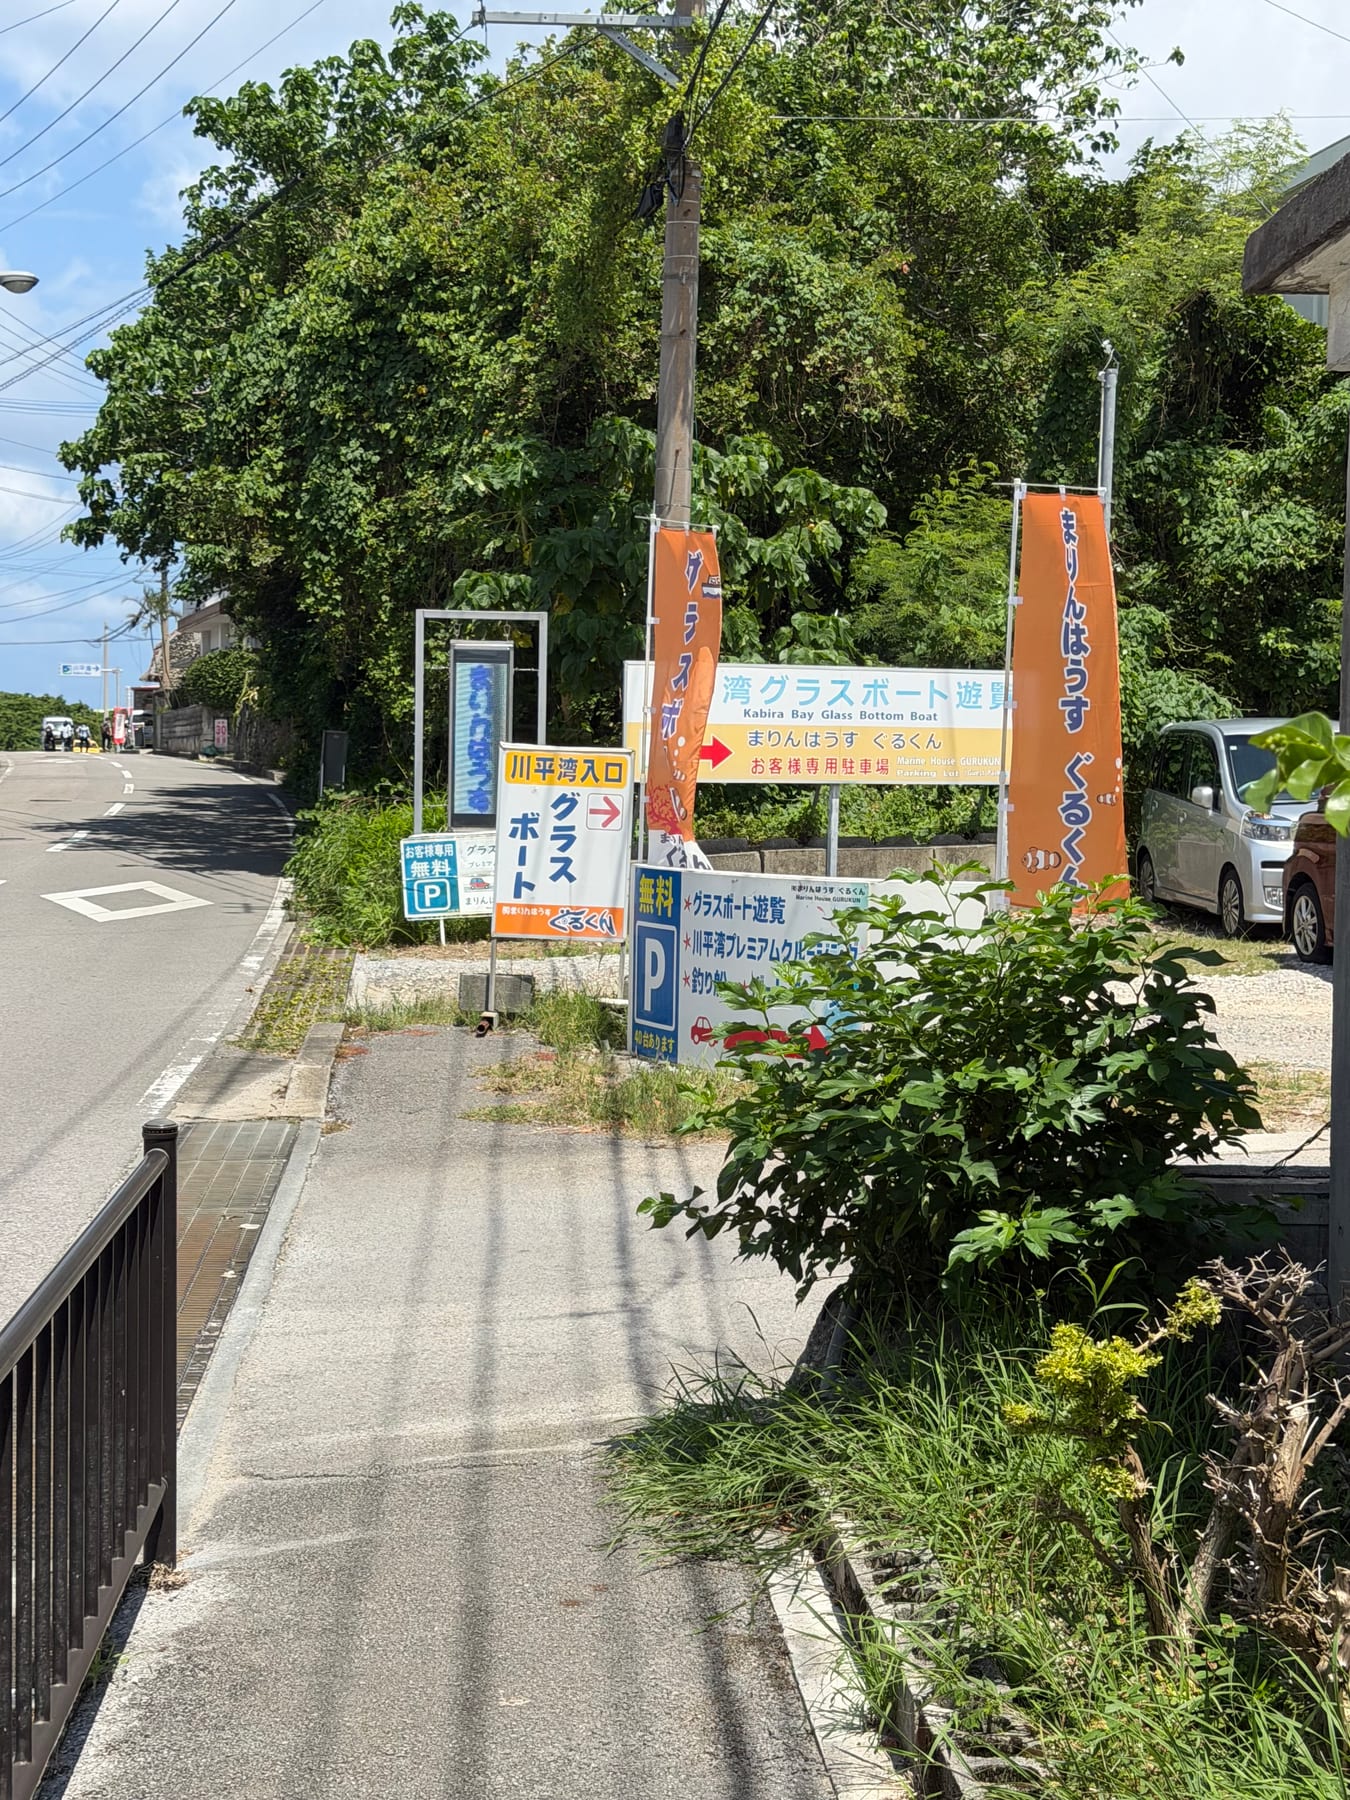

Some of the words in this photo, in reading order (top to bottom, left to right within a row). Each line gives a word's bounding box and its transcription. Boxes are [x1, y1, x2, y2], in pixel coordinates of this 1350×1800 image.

[1059, 507, 1090, 734] まりんはうす
[743, 708, 784, 719] Kabira
[791, 709, 815, 721] Bay
[821, 710, 853, 720] Glass
[859, 711, 904, 721] Bottom
[910, 711, 939, 721] Boat
[748, 730, 859, 748] まりんはうす
[873, 733, 942, 750] ぐるくん
[510, 754, 623, 784] 川平湾入口
[750, 757, 890, 776] お客様専用駐車場
[896, 756, 926, 766] Marine
[930, 757, 956, 766] House
[960, 757, 1001, 766] GURUKUN
[405, 844, 454, 859] お客様専用
[548, 792, 580, 883] グラス
[411, 859, 452, 878] 無料
[508, 812, 541, 900] ボート
[424, 885, 441, 907] P
[639, 873, 674, 918] 無料
[838, 887, 866, 896] ぐるくん
[692, 890, 786, 925] グラスボート遊覧
[548, 908, 617, 936] ぐるくん
[692, 929, 859, 962] 川平湾プレミアムクルージグ
[643, 937, 666, 1012] P
